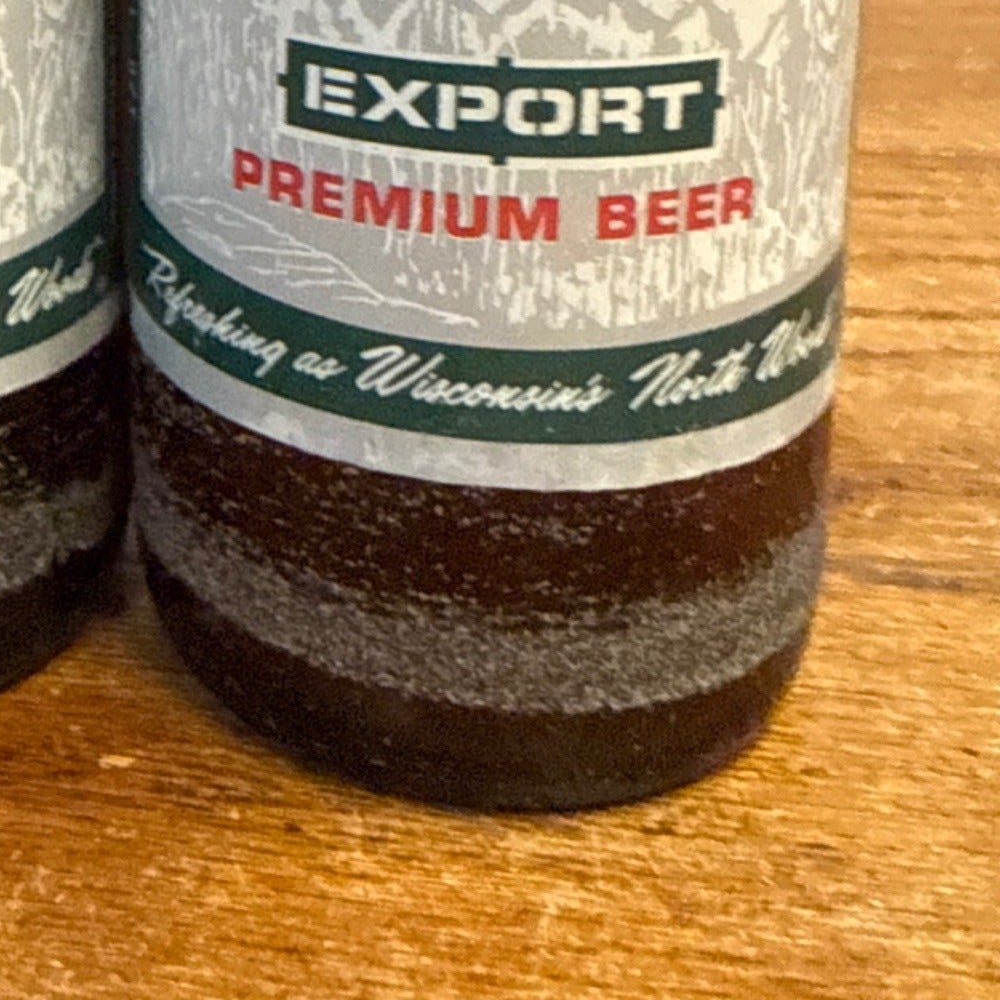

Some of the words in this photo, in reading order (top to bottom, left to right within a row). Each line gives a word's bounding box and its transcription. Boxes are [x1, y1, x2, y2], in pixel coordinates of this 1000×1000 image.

[302, 62, 703, 137] EXPORT
[233, 149, 560, 243] PREMIUM
[596, 175, 755, 241] BEER
[292, 351, 348, 381] as
[355, 344, 614, 412] Wisconsin's
[628, 341, 755, 411] North
